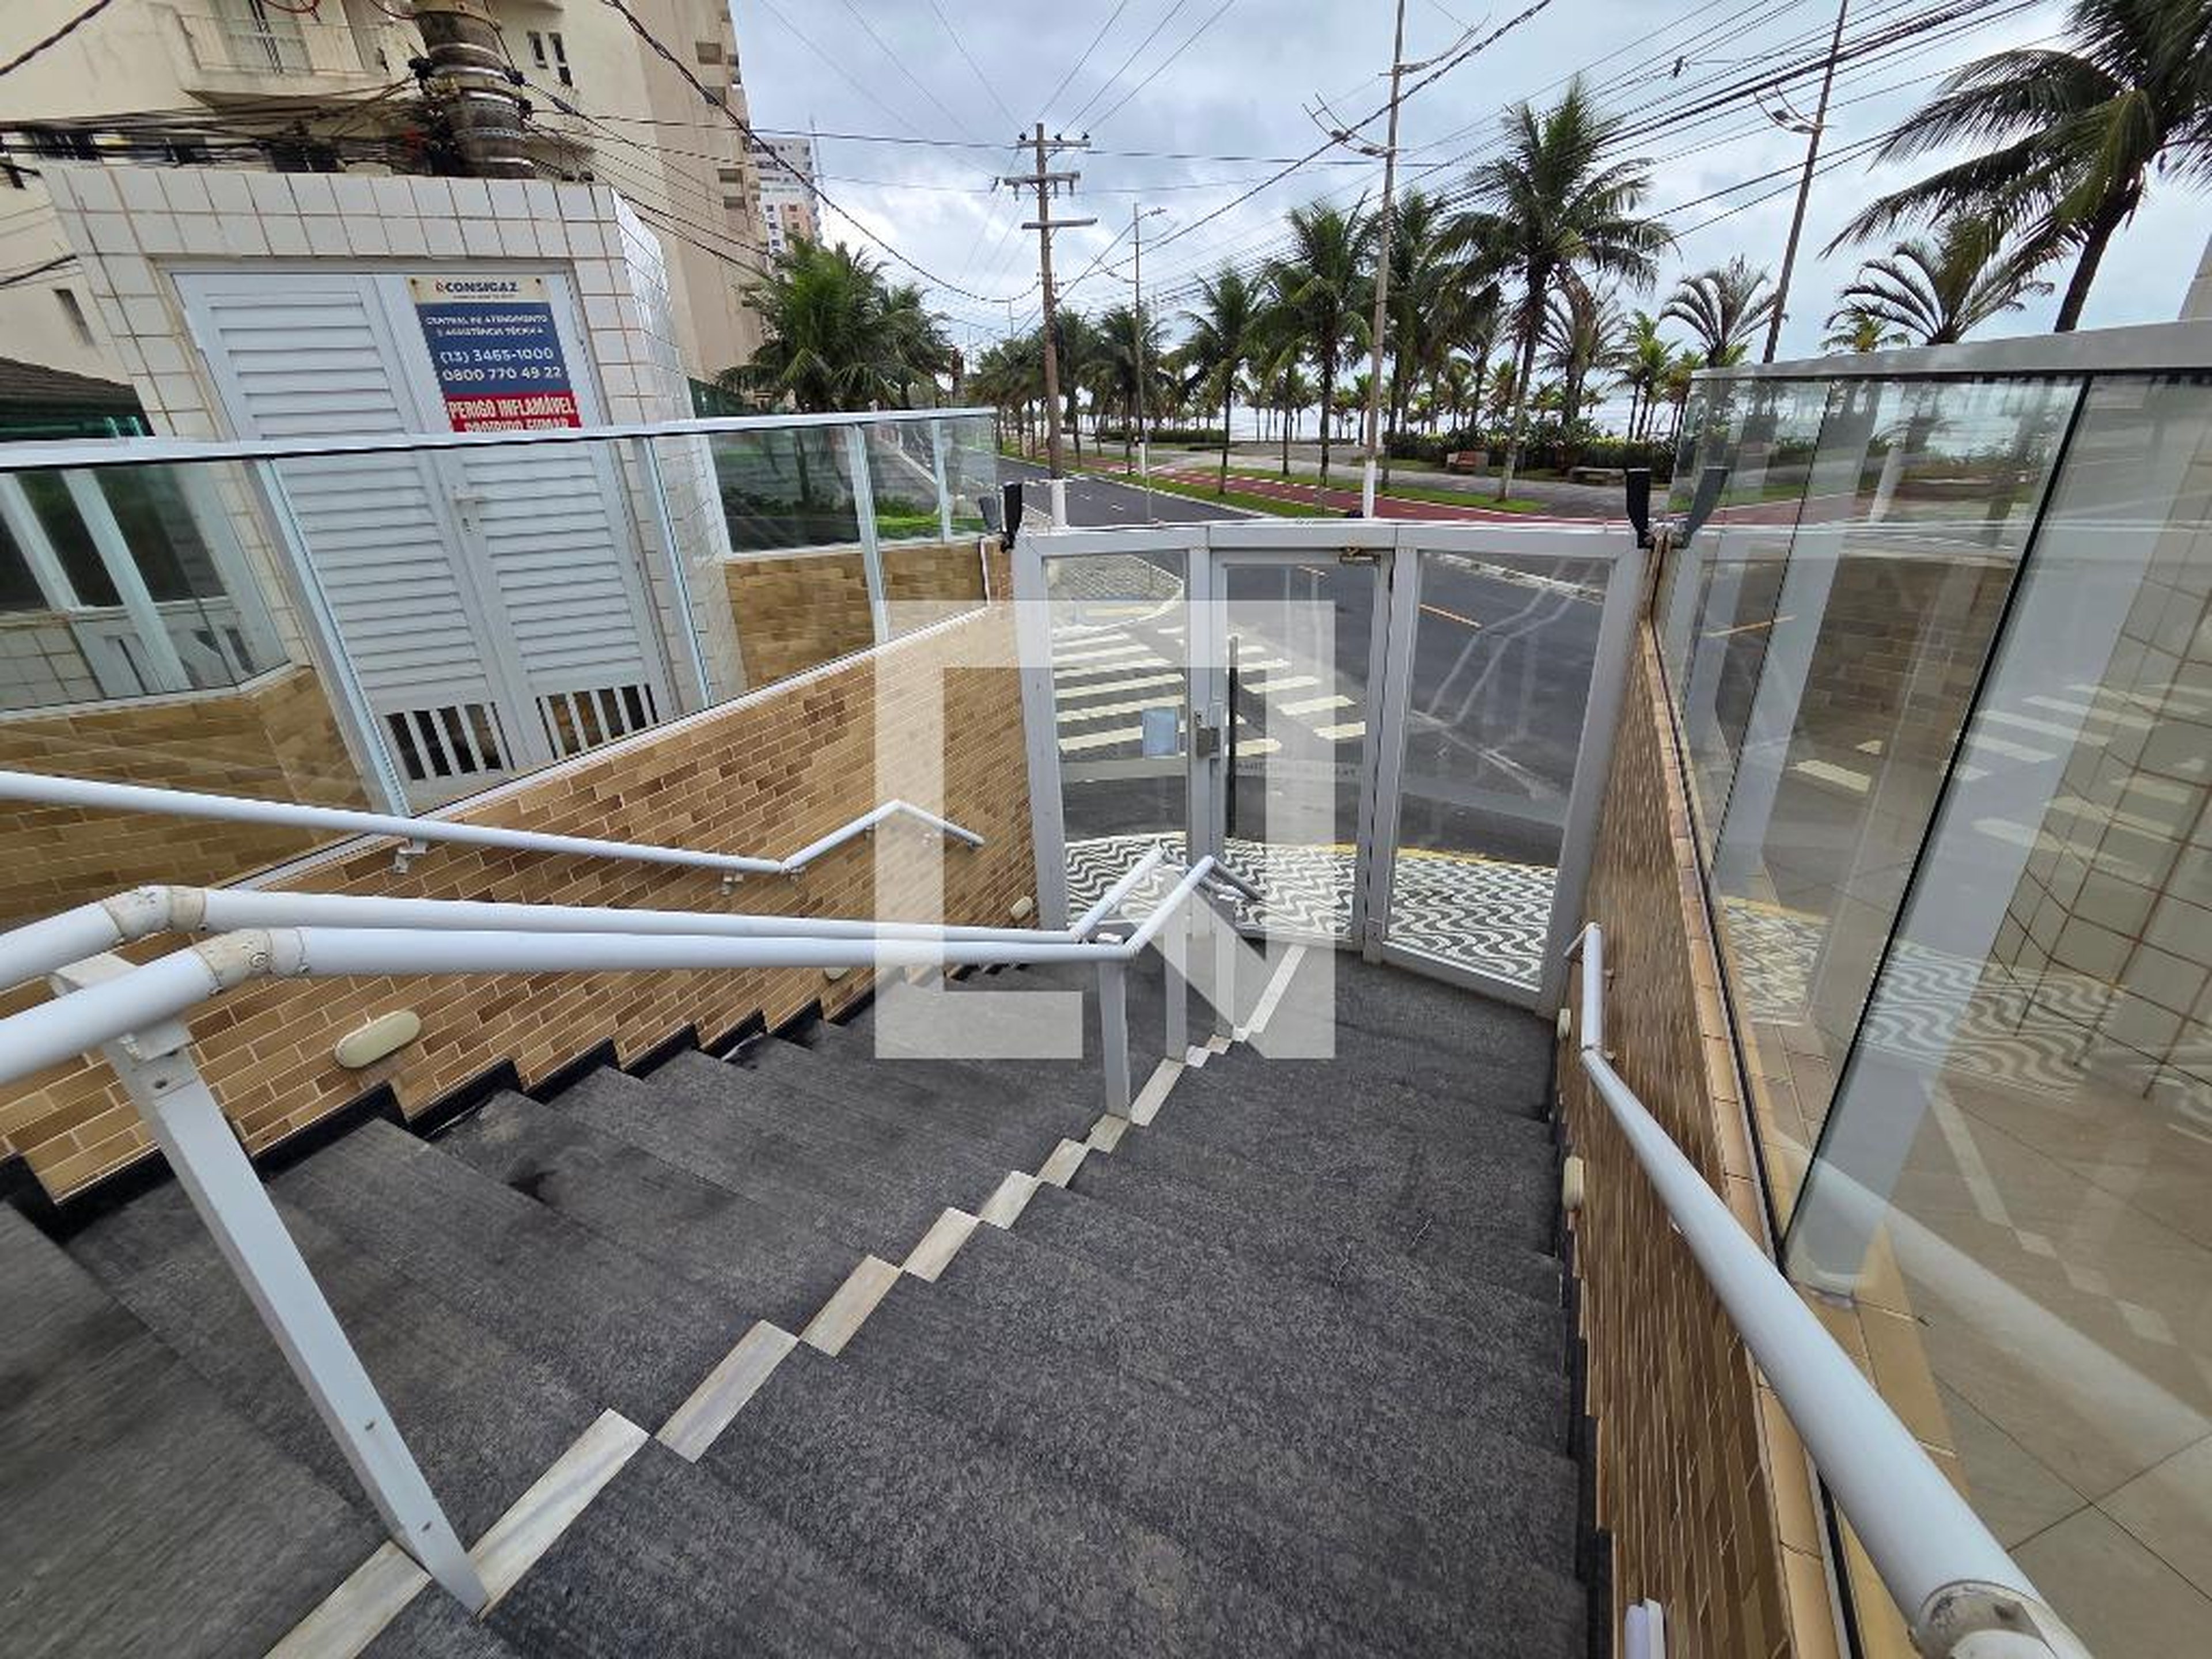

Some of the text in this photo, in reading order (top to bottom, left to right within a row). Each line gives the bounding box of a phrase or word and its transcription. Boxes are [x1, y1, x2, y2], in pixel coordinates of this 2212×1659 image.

[445, 282, 518, 292] CONSIGAZ
[442, 366, 562, 381] 0800 770 49 22
[448, 399, 496, 419] PERIGO
